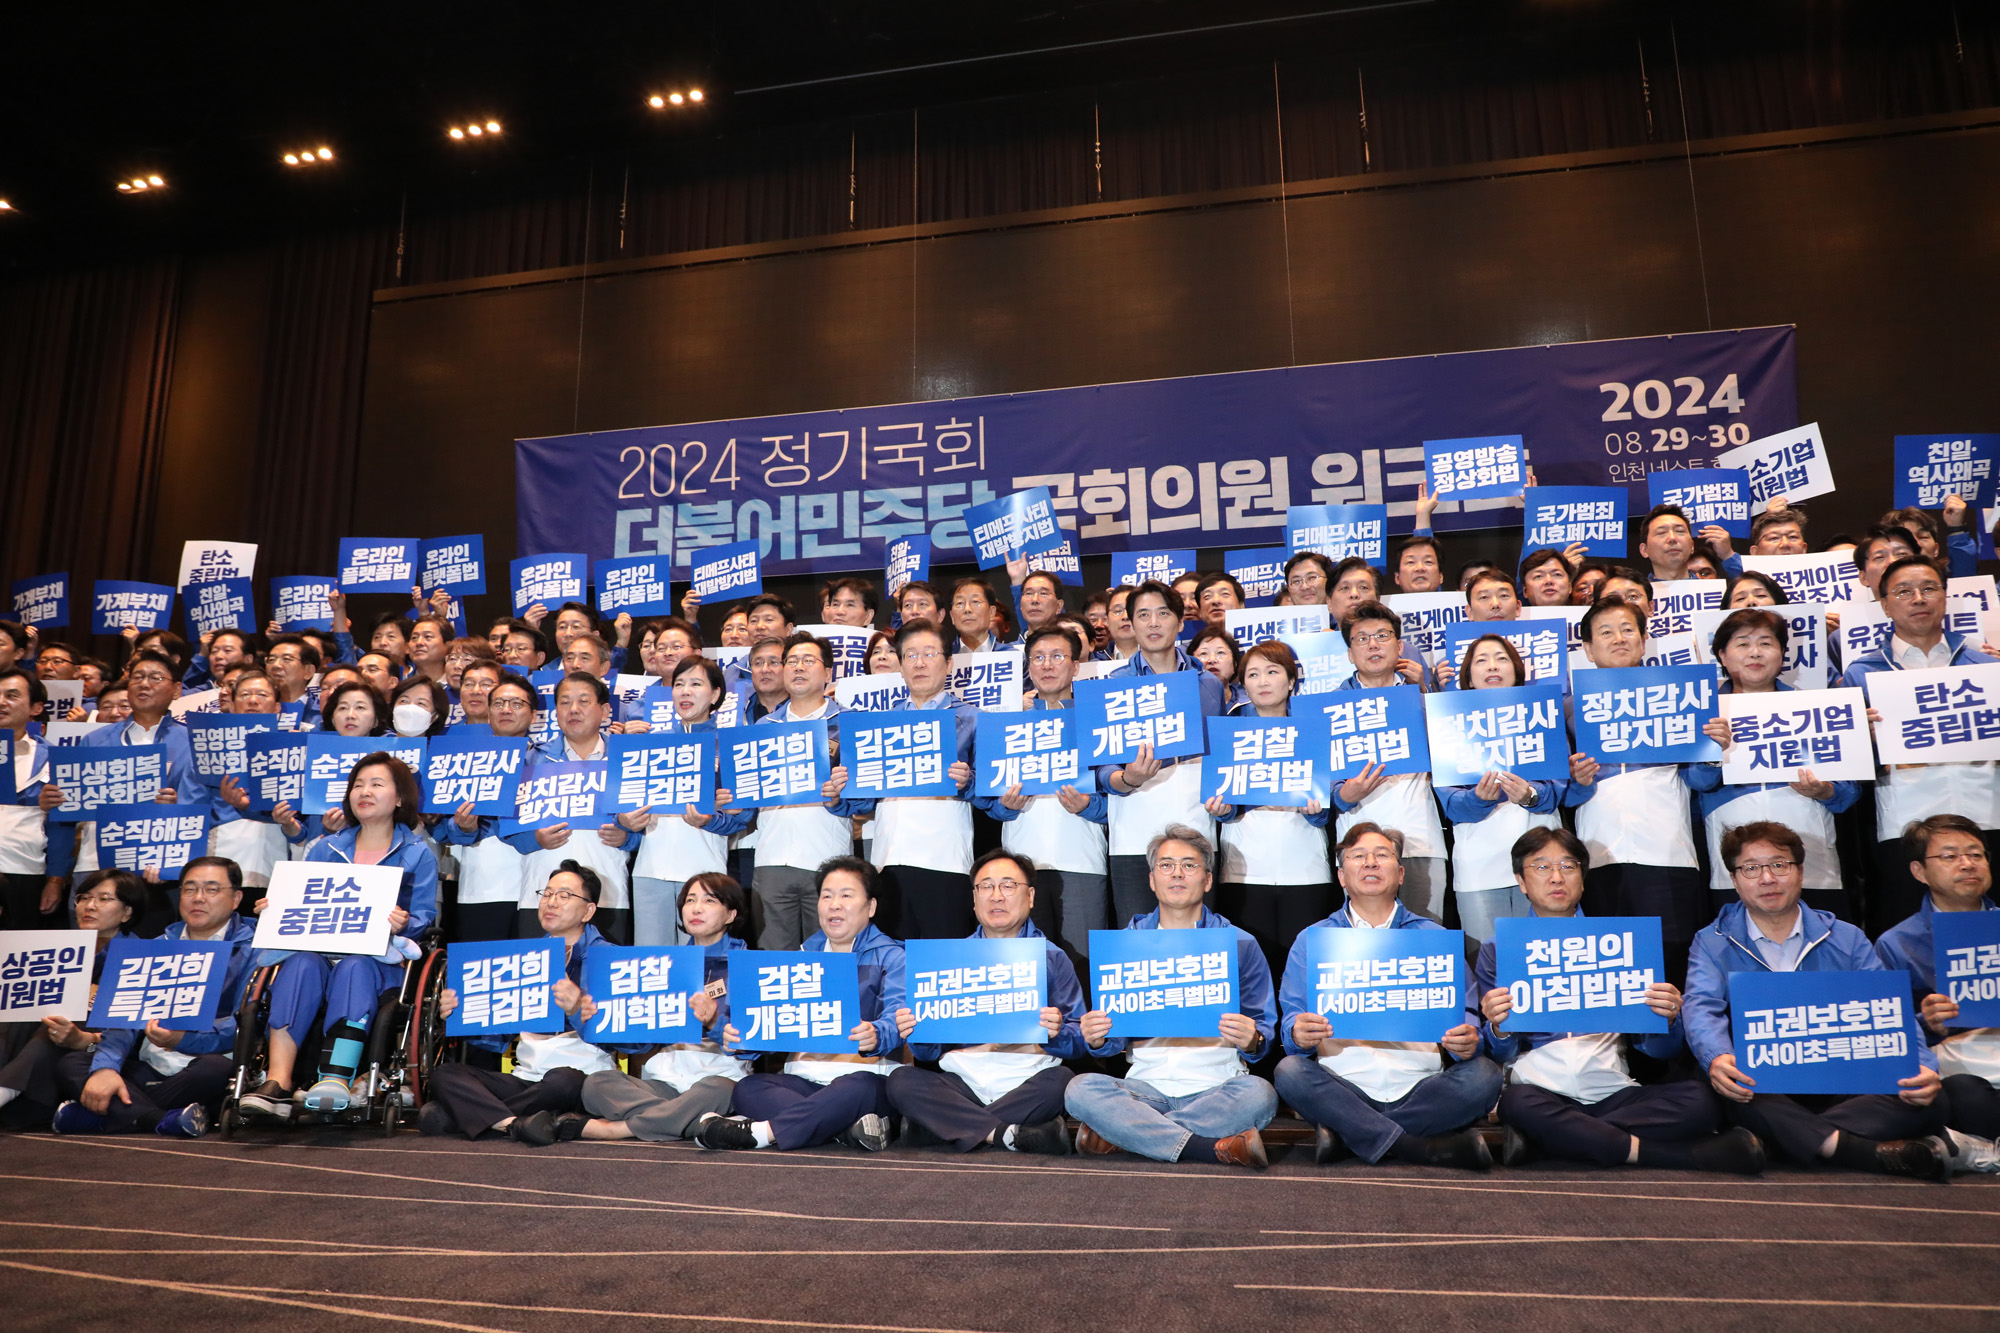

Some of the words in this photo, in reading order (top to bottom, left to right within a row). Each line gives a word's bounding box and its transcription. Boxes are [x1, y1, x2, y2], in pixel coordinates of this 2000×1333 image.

[1600, 373, 1745, 422] 2024
[618, 438, 741, 499] 2024
[761, 415, 985, 487] 정기국회
[1431, 444, 1517, 475] 공영방송
[1608, 461, 1646, 484] 인천
[1738, 438, 1816, 482] 소기업
[1908, 458, 1991, 485] 역사왜곡
[1433, 462, 1520, 494] 정상화법
[1663, 482, 1738, 506] 국가범죄
[613, 480, 997, 567] 더불어민주당
[1012, 456, 1288, 540] 국회의원
[973, 500, 1050, 543] 티메프사태
[1537, 501, 1615, 524] 국가범죄
[1682, 502, 1748, 524] 효폐지법
[979, 517, 1055, 560] 재발방지법
[1292, 519, 1381, 547] 티메프사태
[1527, 521, 1623, 546] 시효폐지법
[200, 550, 233, 567] 탄소
[351, 545, 405, 566] 온라인
[426, 543, 469, 569] 온라인
[693, 551, 756, 582] 티메프사태
[1026, 556, 1079, 578] 효폐지법
[1229, 561, 1288, 584] 티메프사
[341, 562, 412, 586] 플랫폼법
[422, 561, 479, 590] 플랫폼법
[520, 561, 572, 588] 온라인
[605, 563, 655, 591] 온라인
[693, 566, 757, 597] 재발방지법
[1771, 561, 1859, 589] 전게이트
[14, 581, 64, 612] 가계부채
[96, 591, 168, 612] 가계부채
[190, 596, 245, 621] 역사왜곡
[279, 584, 331, 606] 온라인
[515, 578, 581, 609] 플랫폼법
[599, 581, 664, 612] 플랫폼법
[1786, 583, 1853, 604] 정조사
[19, 601, 58, 626] 지원법
[104, 609, 157, 629] 지원법
[275, 602, 334, 625] 플랫폼법
[945, 660, 1013, 691] 생기본
[1104, 682, 1167, 722] 검찰
[1582, 679, 1713, 723] 정치감사
[1914, 678, 1987, 715] 탄소
[1323, 697, 1389, 736] 검찰
[1438, 699, 1558, 745] 정치감사
[1600, 713, 1696, 753] 방지법
[1731, 703, 1854, 743] 중소기업
[1901, 707, 2000, 750] 중립법
[732, 730, 814, 772] 김건희
[855, 720, 941, 760] 김건희
[1004, 718, 1065, 754] 검찰
[1092, 711, 1186, 757] 개혁법
[1233, 726, 1299, 761] 검찰
[196, 749, 248, 775] 정상화
[251, 745, 307, 777] 순직해
[427, 749, 520, 780] 정치감사
[622, 743, 702, 778] 김건희
[989, 749, 1079, 789] 개혁법
[1455, 733, 1546, 774] 방지법
[1749, 734, 1842, 770] 지원법
[56, 753, 161, 787] 민생회복
[735, 761, 816, 801] 특검법
[856, 753, 942, 790] 특검법
[1215, 759, 1314, 796] 개혁법
[57, 776, 162, 812] 정상화법
[261, 774, 306, 802] 특검
[432, 775, 503, 805] 방지법
[618, 773, 702, 808] 특검법
[517, 793, 596, 825] 방지법
[100, 815, 204, 848] 순직해병
[114, 842, 191, 872] 특검법
[303, 876, 362, 905] 탄소
[278, 906, 372, 936] 중립법
[1, 945, 85, 980] 상공인
[117, 951, 215, 989] 김건희
[1524, 930, 1635, 976] 천원의
[462, 949, 550, 994] 김건희
[609, 955, 673, 996] 검찰
[758, 962, 825, 1002] 검찰
[914, 960, 1038, 999] 교권보호법
[1098, 951, 1229, 992] 교권보호법
[1315, 954, 1455, 990] 교권보호법
[107, 984, 207, 1022] 특검법
[461, 984, 550, 1027] 특검법
[914, 989, 1039, 1023] (서이초특별법)
[1098, 981, 1231, 1016] (서이초특별법)
[1316, 985, 1456, 1016] (서이초특별법)
[1510, 968, 1655, 1015] 아침밥법
[595, 991, 687, 1034] 개혁법
[745, 1000, 843, 1041] 개혁법
[1743, 996, 1903, 1041] 교권보호법
[1746, 1031, 1908, 1068] (서이초특별법)
